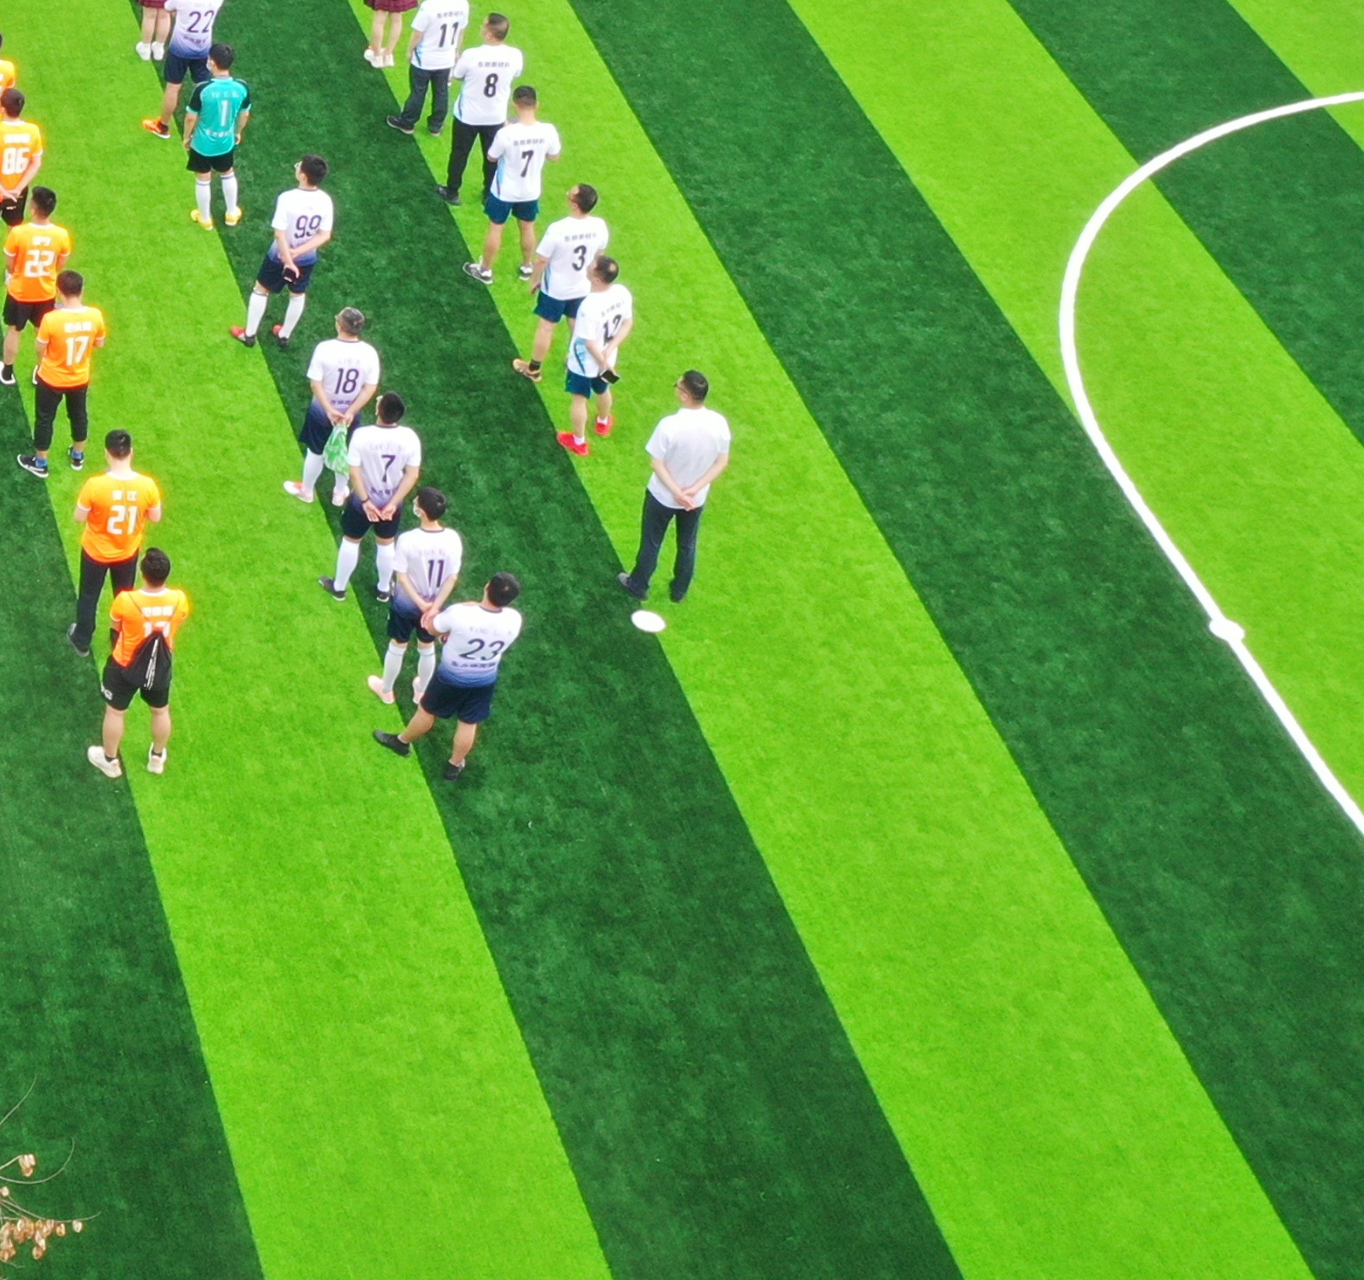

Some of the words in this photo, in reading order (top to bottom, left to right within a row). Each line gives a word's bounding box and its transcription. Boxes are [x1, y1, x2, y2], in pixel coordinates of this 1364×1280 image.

[187, 10, 214, 34] 22
[438, 21, 459, 48] 11
[483, 73, 498, 98] 8
[220, 99, 231, 127] 1
[2, 147, 31, 176] 86
[520, 149, 534, 178] 7
[294, 215, 322, 239] 99
[24, 249, 56, 278] 22
[572, 245, 587, 272] 3
[66, 336, 90, 366] 17
[334, 368, 359, 395] 18
[381, 455, 396, 482] 7
[107, 504, 138, 536] 21
[428, 559, 445, 588] 11
[459, 638, 505, 661] 23
